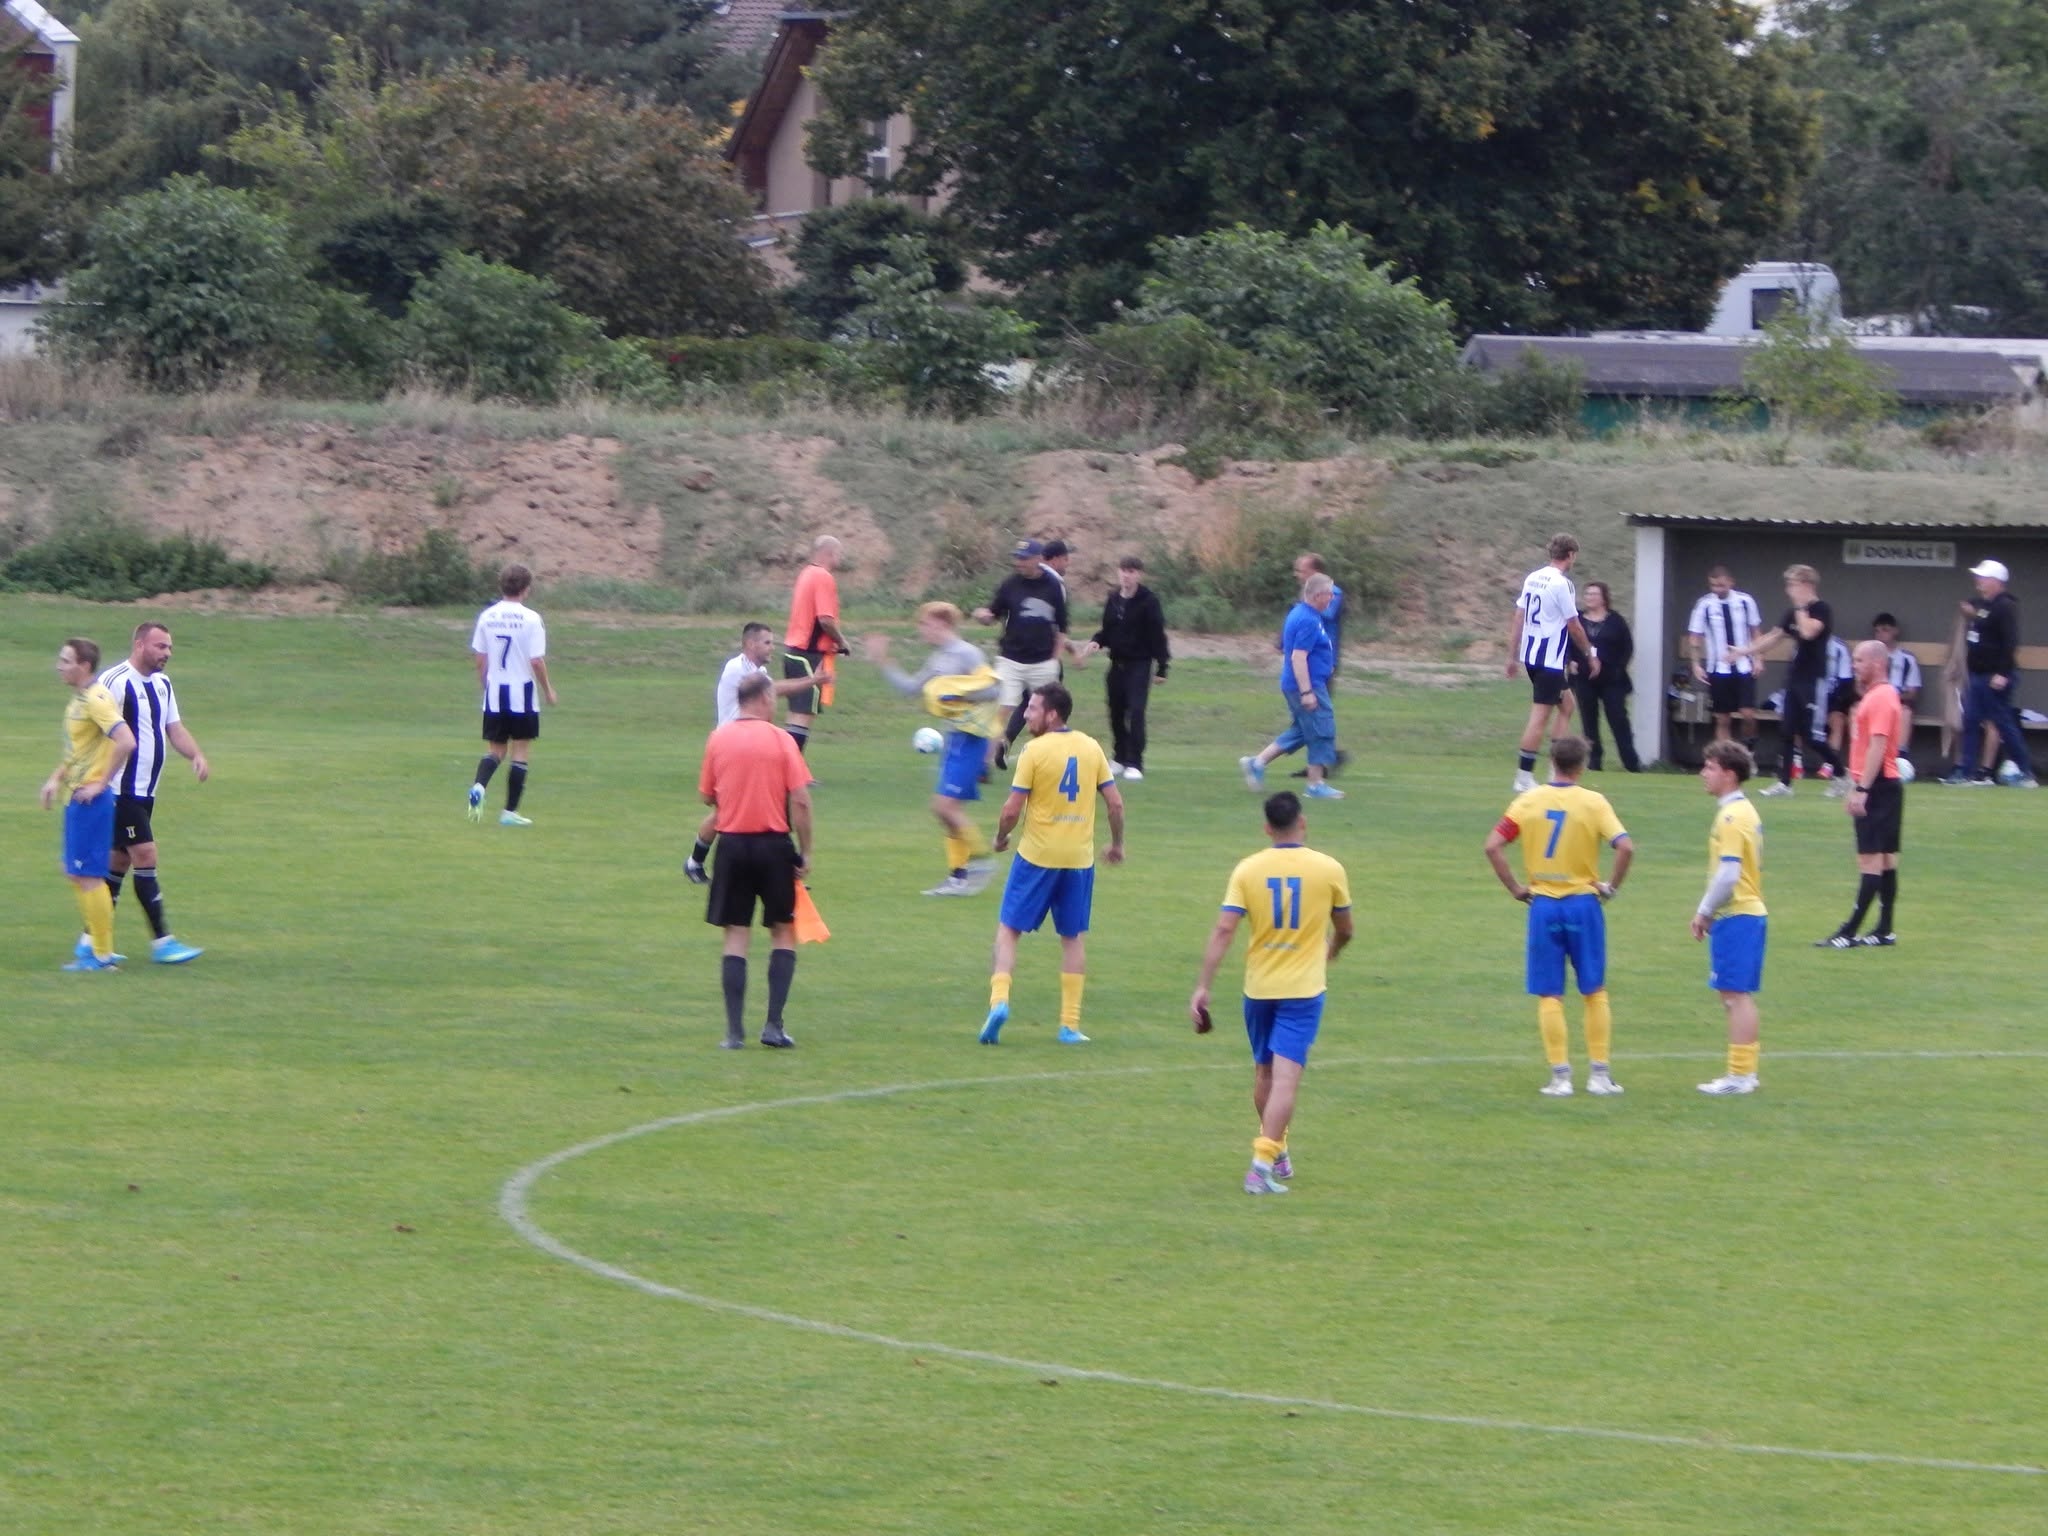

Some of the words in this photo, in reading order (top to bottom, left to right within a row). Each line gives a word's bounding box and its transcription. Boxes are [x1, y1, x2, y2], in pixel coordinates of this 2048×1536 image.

[1525, 592, 1541, 625] 12
[496, 635, 512, 669] 7
[1059, 756, 1080, 802] 4
[1545, 810, 1566, 858] 7
[1267, 877, 1301, 929] 11
